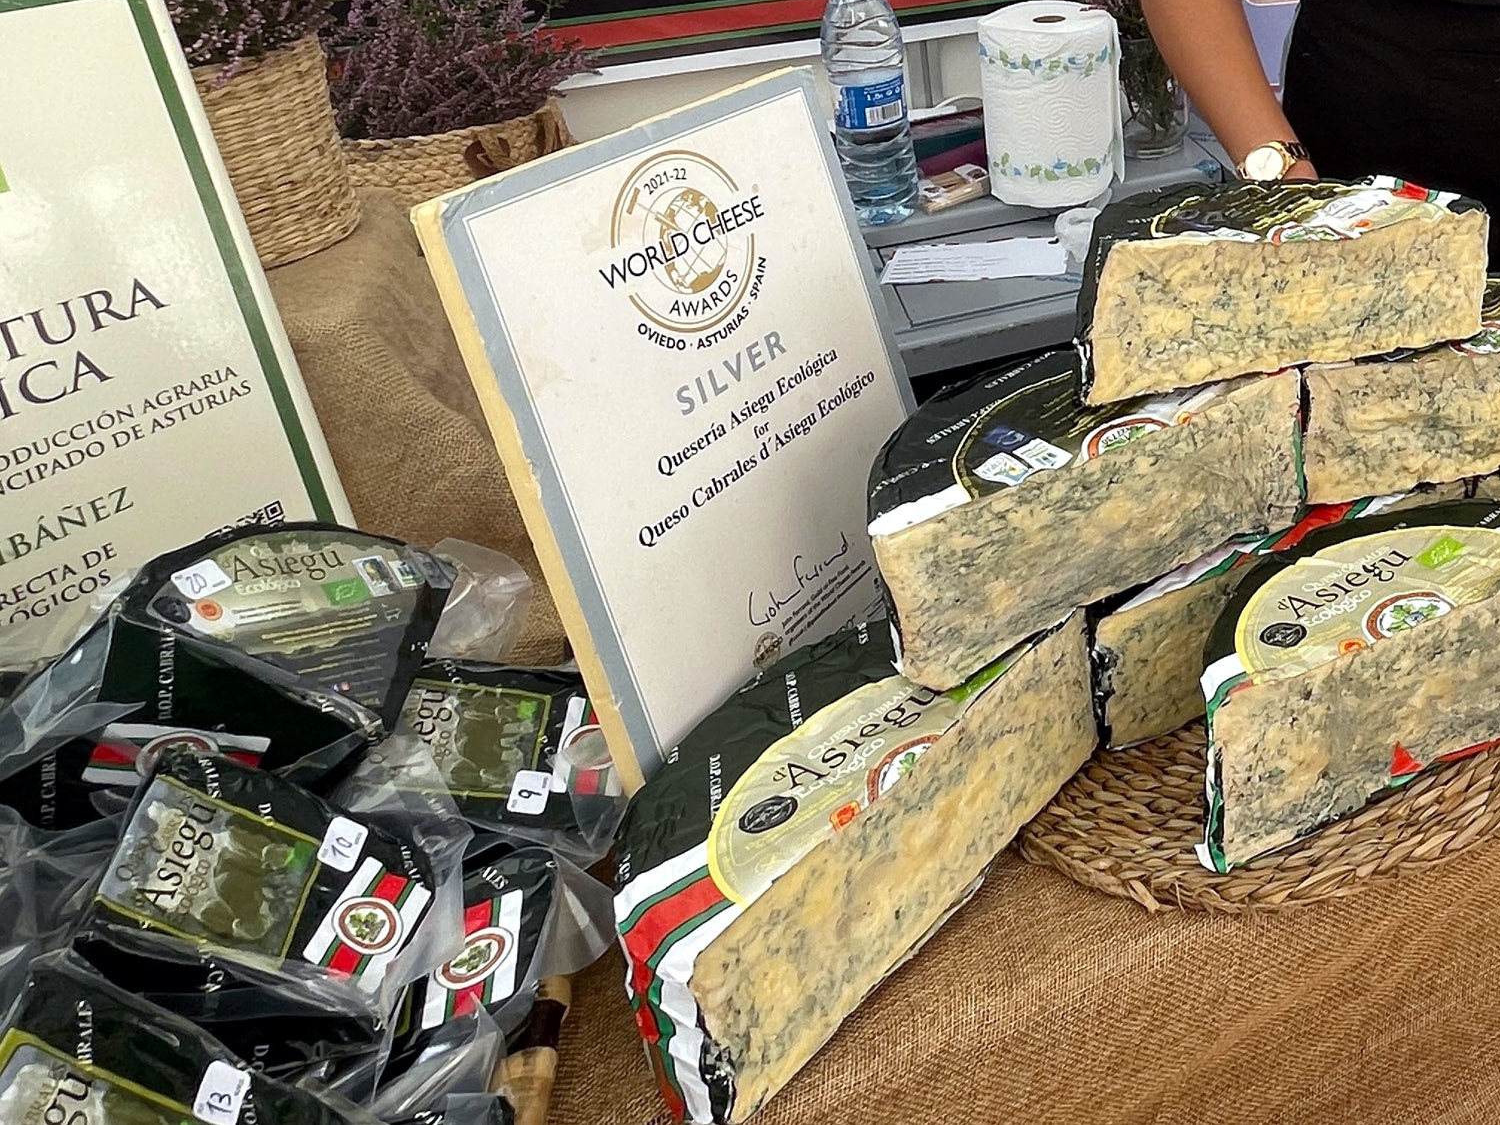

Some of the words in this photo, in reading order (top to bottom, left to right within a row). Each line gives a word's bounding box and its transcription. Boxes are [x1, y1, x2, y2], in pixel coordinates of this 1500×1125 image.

[643, 167, 688, 196] 2021-22
[598, 231, 691, 289] WORLD
[692, 194, 766, 245] CHEESE
[637, 322, 687, 351] OVIEDO
[696, 306, 750, 351] ASTURIAS
[749, 256, 767, 301] SPAIN
[668, 268, 739, 317] AWARDS
[142, 365, 239, 415] AGRARIA
[675, 330, 788, 417] SILVER
[111, 423, 146, 449] DE
[150, 379, 252, 435] ASTURIAS
[656, 421, 728, 477] Quesería
[729, 391, 777, 431] Asiegu
[775, 347, 839, 399] Ecológica
[752, 420, 771, 440] for
[637, 503, 690, 548] Queso
[690, 454, 759, 509] Cabrales
[815, 368, 876, 420] Ecológico
[81, 541, 118, 571] DE
